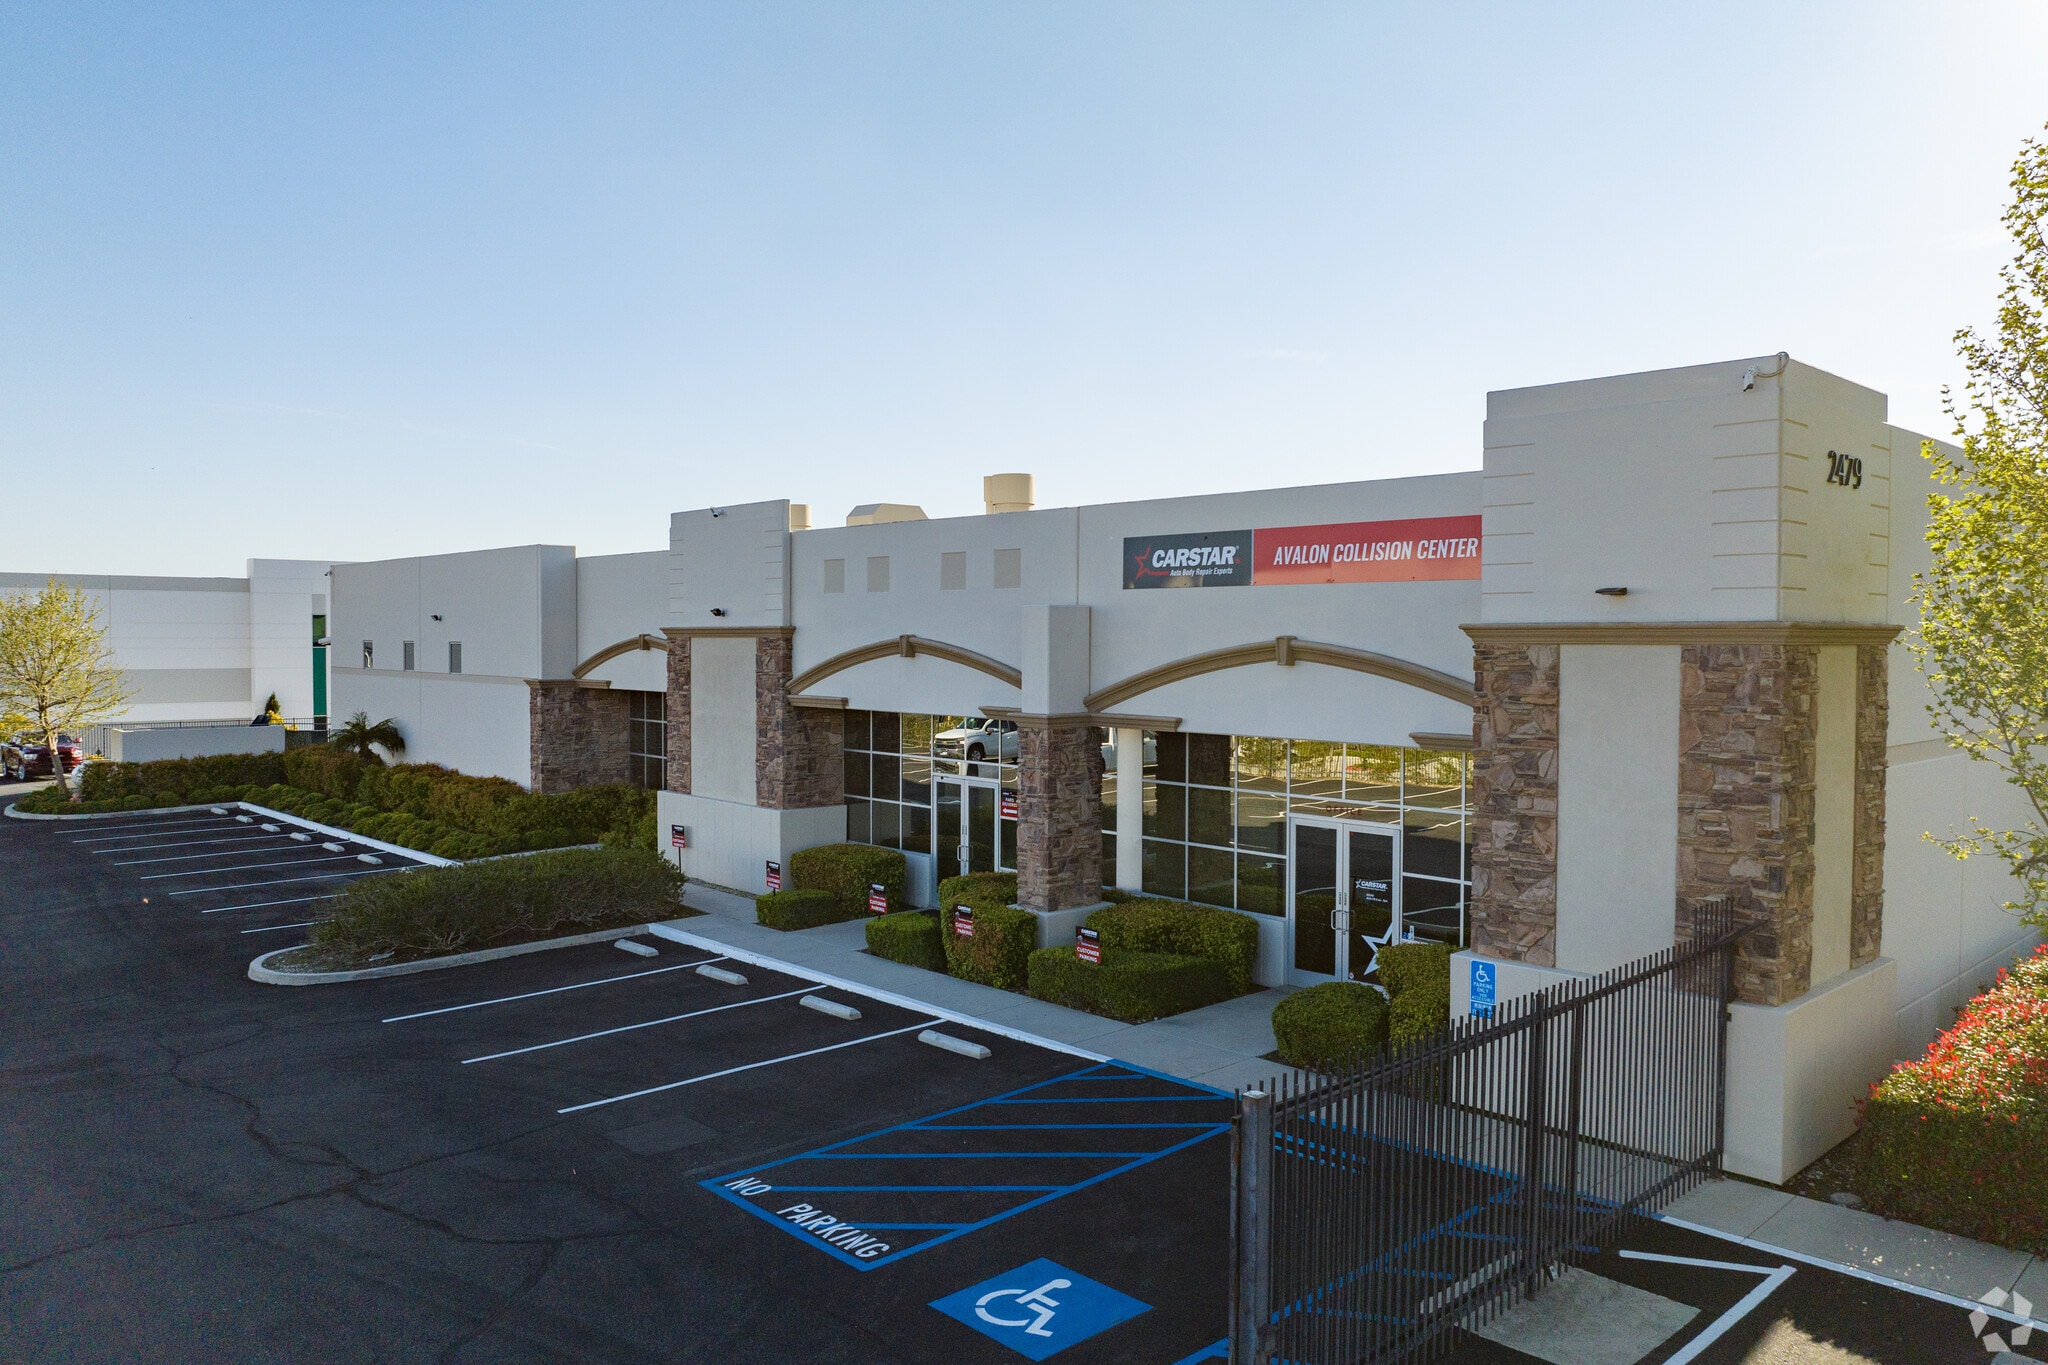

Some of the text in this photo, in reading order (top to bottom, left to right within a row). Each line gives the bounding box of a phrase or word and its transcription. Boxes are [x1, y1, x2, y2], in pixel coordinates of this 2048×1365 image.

[1827, 450, 1862, 489] 2479
[1273, 537, 1479, 565] AVALON COLLISION CENTER
[1152, 546, 1236, 568] CARSTAR
[1170, 567, 1233, 577] Auto Body Repair Experts
[1325, 805, 1363, 816] OFFICE
[1361, 881, 1387, 889] CARSTAR
[1077, 946, 1099, 956] CUSTOMER
[1079, 953, 1097, 962] PARKING
[1473, 982, 1493, 990] PARKING
[724, 1176, 890, 1258] NO PARKING
